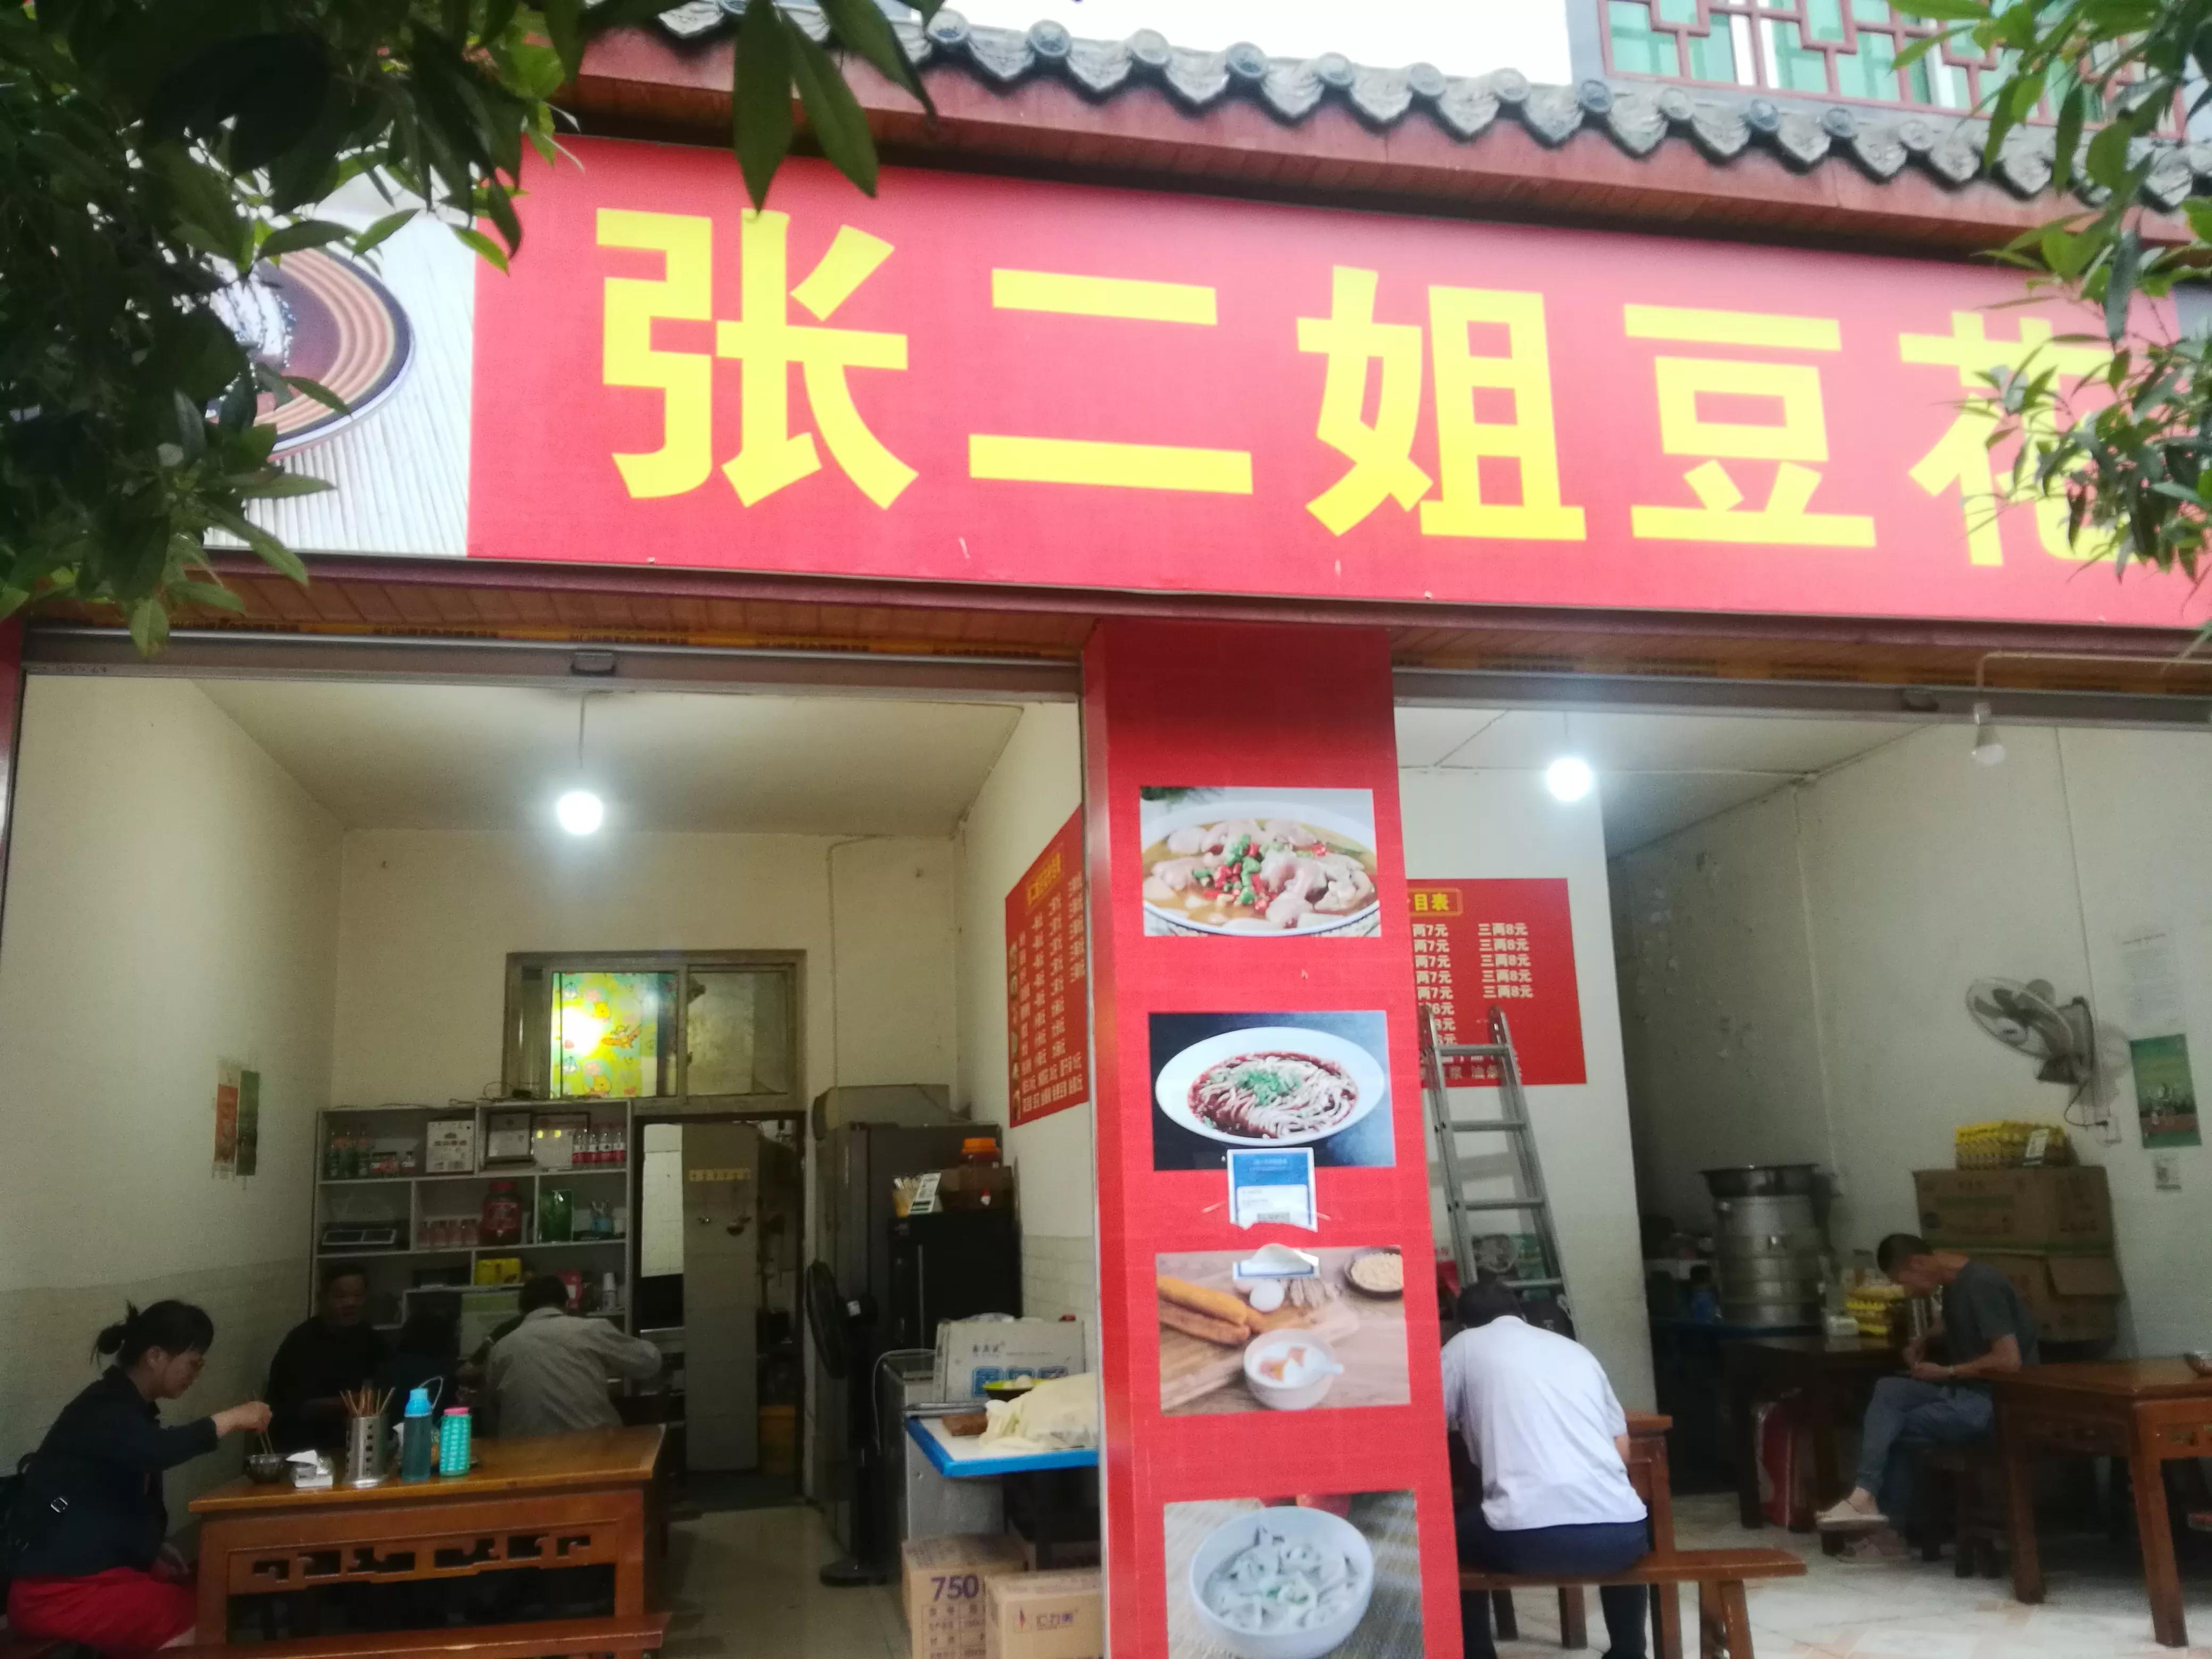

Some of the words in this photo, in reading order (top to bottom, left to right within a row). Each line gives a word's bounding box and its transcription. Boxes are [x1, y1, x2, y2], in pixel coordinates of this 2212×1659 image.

[597, 207, 2139, 566] 张二姐豆花
[932, 1574, 979, 1602] 750
